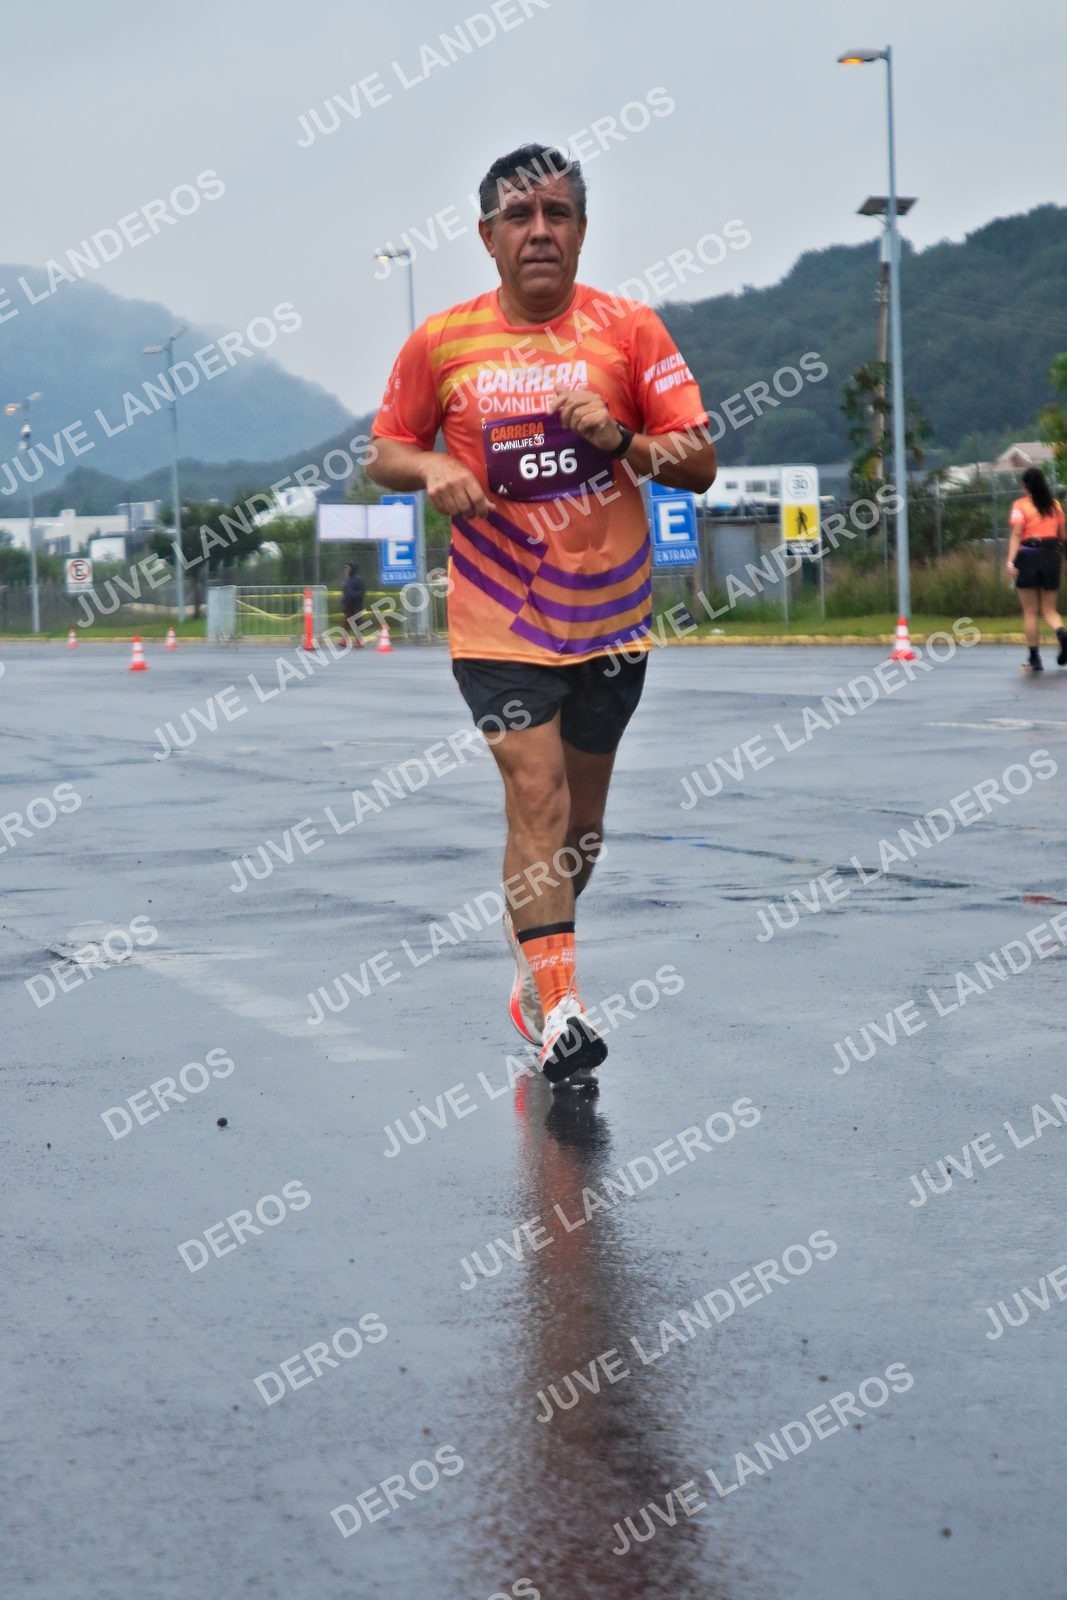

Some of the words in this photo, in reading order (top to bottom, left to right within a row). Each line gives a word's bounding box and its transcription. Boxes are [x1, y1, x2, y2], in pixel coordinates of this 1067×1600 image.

[477, 360, 588, 393] CARRERA
[478, 393, 557, 414] OMNILIF
[491, 421, 545, 442] CARRERA
[492, 438, 533, 452] OMNILIFE
[519, 448, 578, 480] 656
[658, 501, 690, 542] E
[388, 540, 412, 565] E
[657, 548, 698, 562] ENTRADA
[74, 563, 87, 577] E
